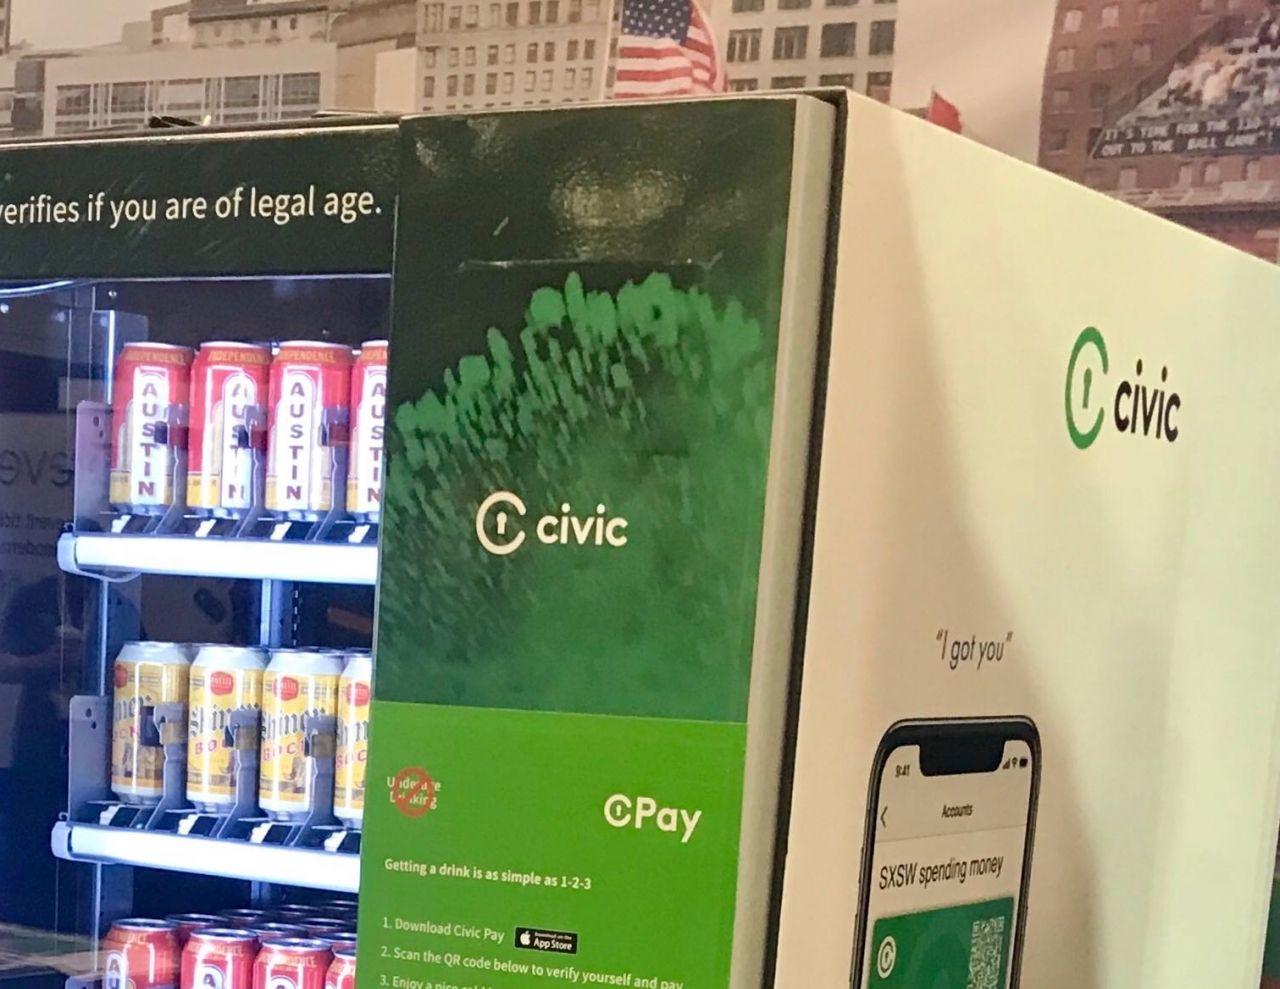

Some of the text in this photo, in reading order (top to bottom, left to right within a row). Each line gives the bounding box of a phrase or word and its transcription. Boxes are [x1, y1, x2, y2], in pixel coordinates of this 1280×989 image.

[86, 192, 106, 222] if
[110, 198, 157, 229] you
[165, 196, 208, 220] are
[215, 188, 243, 219] of
[250, 185, 315, 225] legal
[324, 189, 382, 224] age.
[1114, 358, 1181, 442] civic
[138, 382, 158, 496] AUSTIN
[286, 382, 305, 499] AUSTIN
[367, 382, 385, 500] AUSTIN
[537, 503, 628, 546] civic
[949, 635, 976, 670] got
[895, 764, 911, 778] 9:41
[941, 804, 973, 818] Accounts
[385, 858, 591, 890] Getting a drink is as simple as 1-2-3
[879, 855, 1004, 890] SXSW spending money
[383, 917, 504, 944] 1. Download Civic Pay
[533, 938, 572, 951] App Store
[380, 974, 389, 986] 3.
[381, 946, 391, 958] 2.
[393, 947, 420, 961] Scan
[422, 950, 442, 964] the
[444, 953, 461, 967] QR
[463, 955, 491, 970] code
[494, 958, 529, 974] below
[532, 964, 544, 977] to
[546, 966, 580, 983] verify
[582, 971, 632, 987] yourself
[634, 976, 658, 989] and
